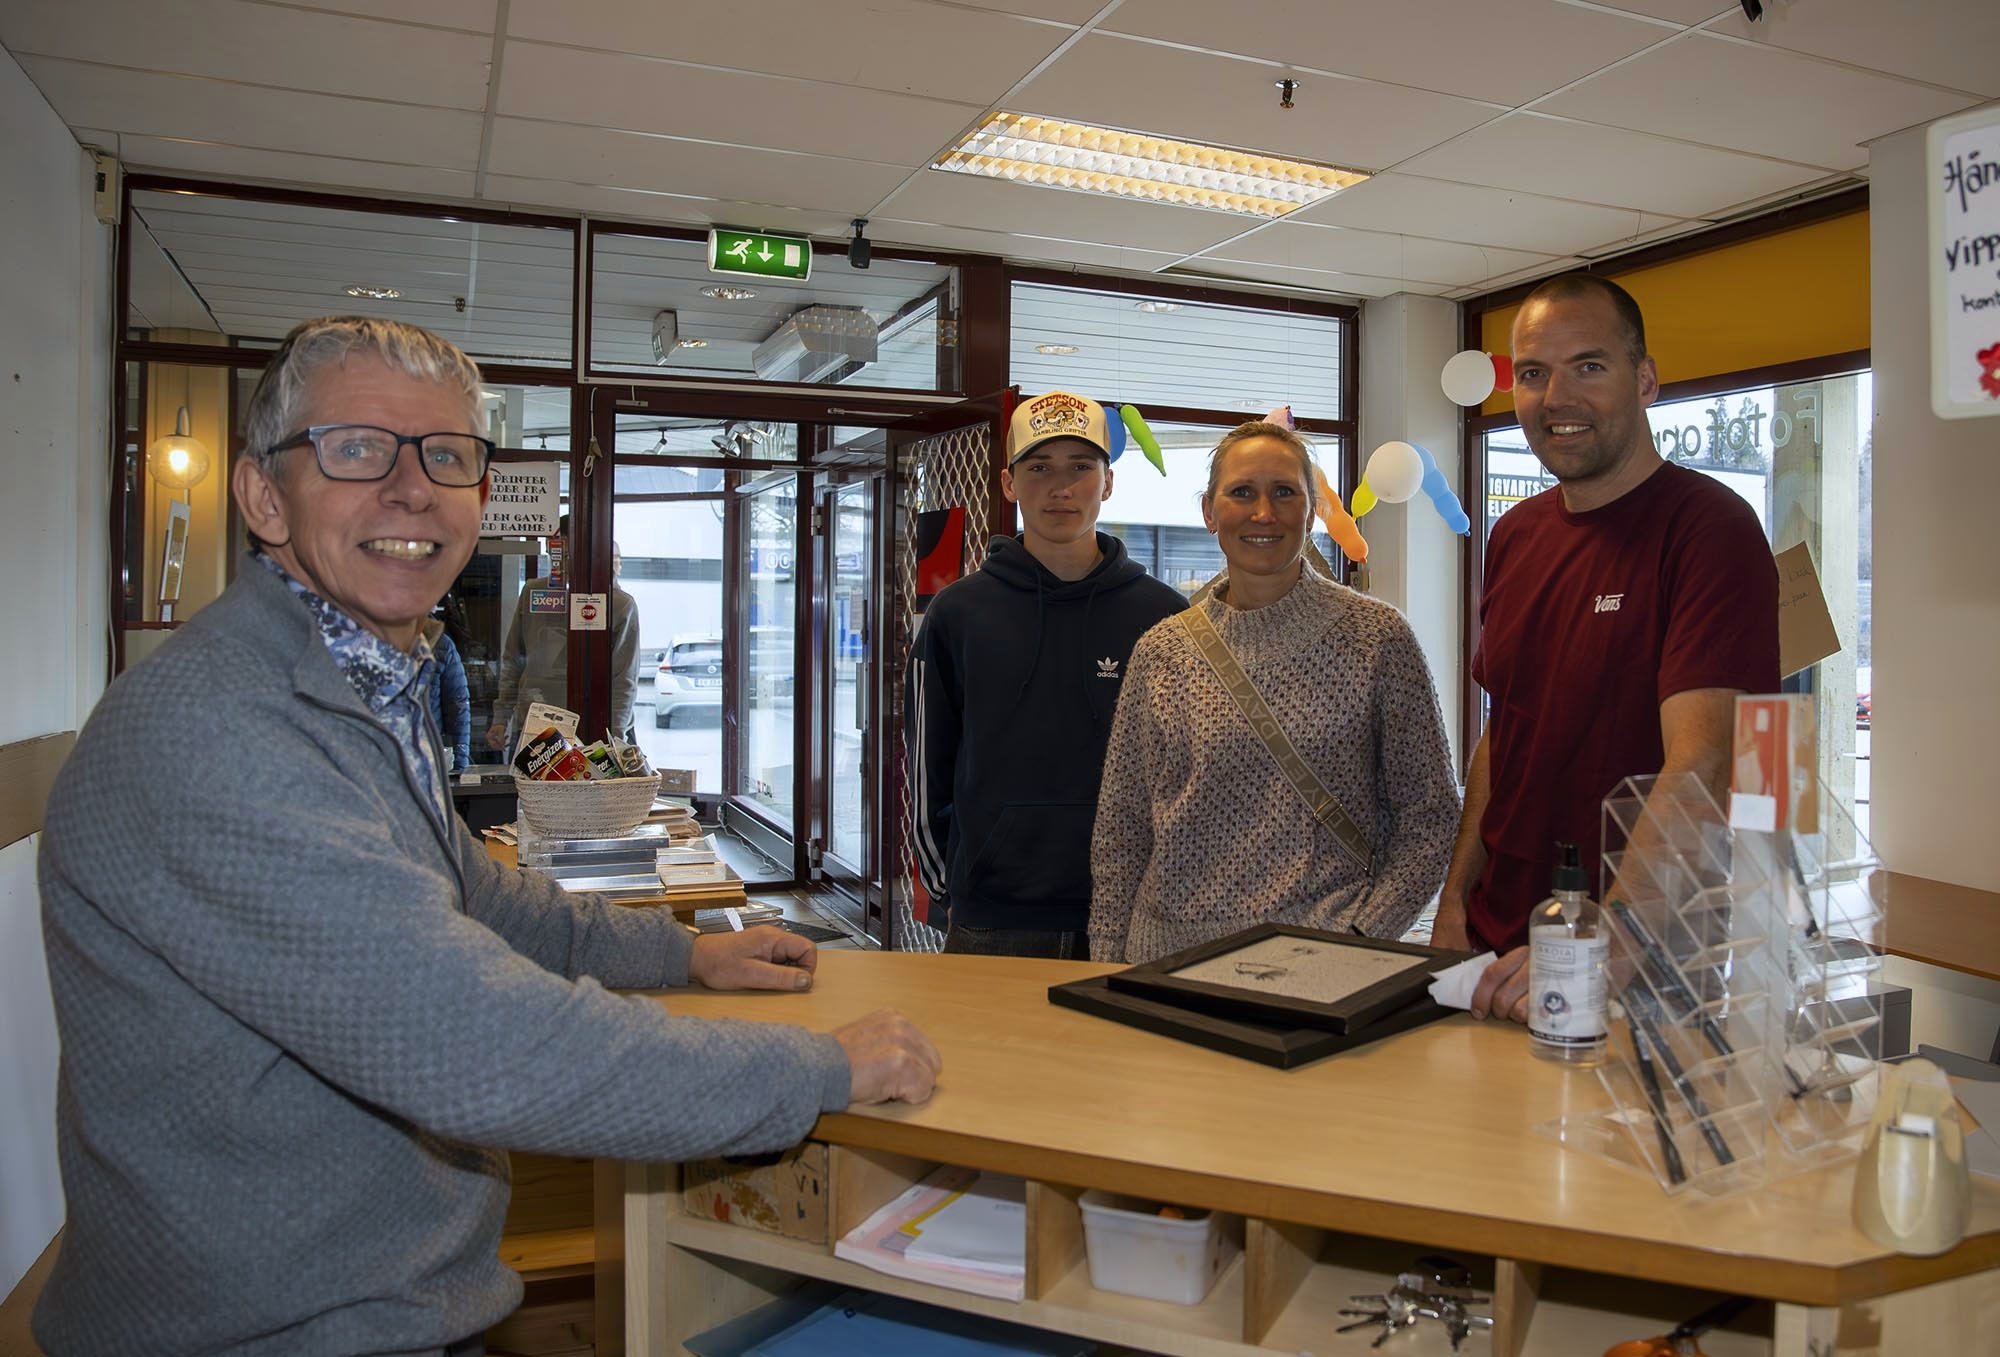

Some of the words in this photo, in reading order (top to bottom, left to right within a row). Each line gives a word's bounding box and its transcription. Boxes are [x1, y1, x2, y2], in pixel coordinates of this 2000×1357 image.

[1945, 234, 2000, 272] Vipp
[1030, 394, 1088, 414] STETSON
[1033, 428, 1062, 438] GAMBLING
[1064, 428, 1087, 436] GRIFTER
[493, 475, 548, 485] PRINTER
[524, 486, 547, 494] FRA
[493, 513, 510, 521] EN
[514, 514, 547, 522] GAVE
[500, 524, 545, 532] RAMME
[532, 595, 565, 608] axept
[1594, 593, 1625, 613] Vans
[526, 738, 563, 774] Energizer
